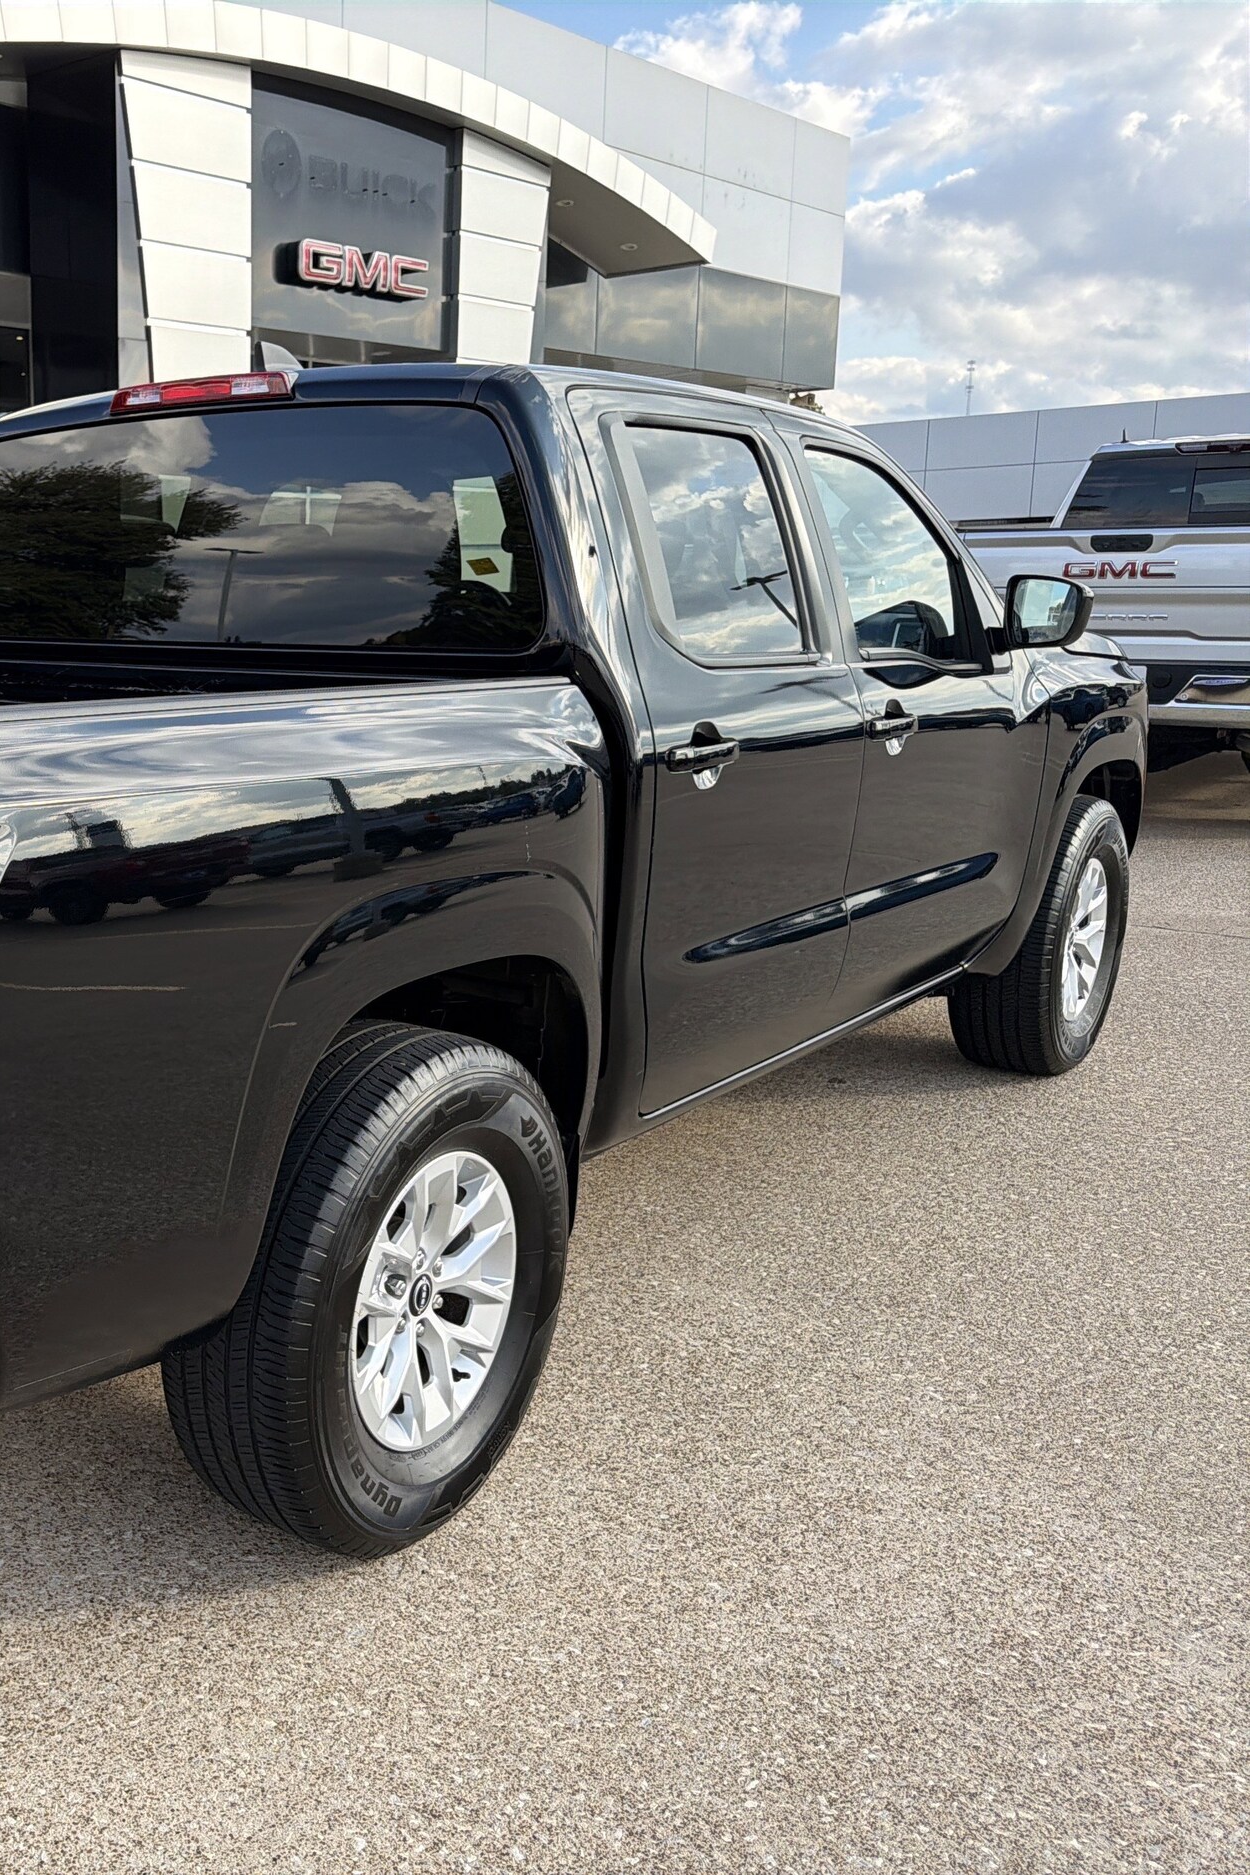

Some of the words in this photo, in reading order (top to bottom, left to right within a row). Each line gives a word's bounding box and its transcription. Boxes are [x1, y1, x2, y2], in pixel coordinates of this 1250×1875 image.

[299, 238, 429, 298] GMC
[1062, 559, 1179, 579] GMC
[1089, 613, 1168, 621] ERRA
